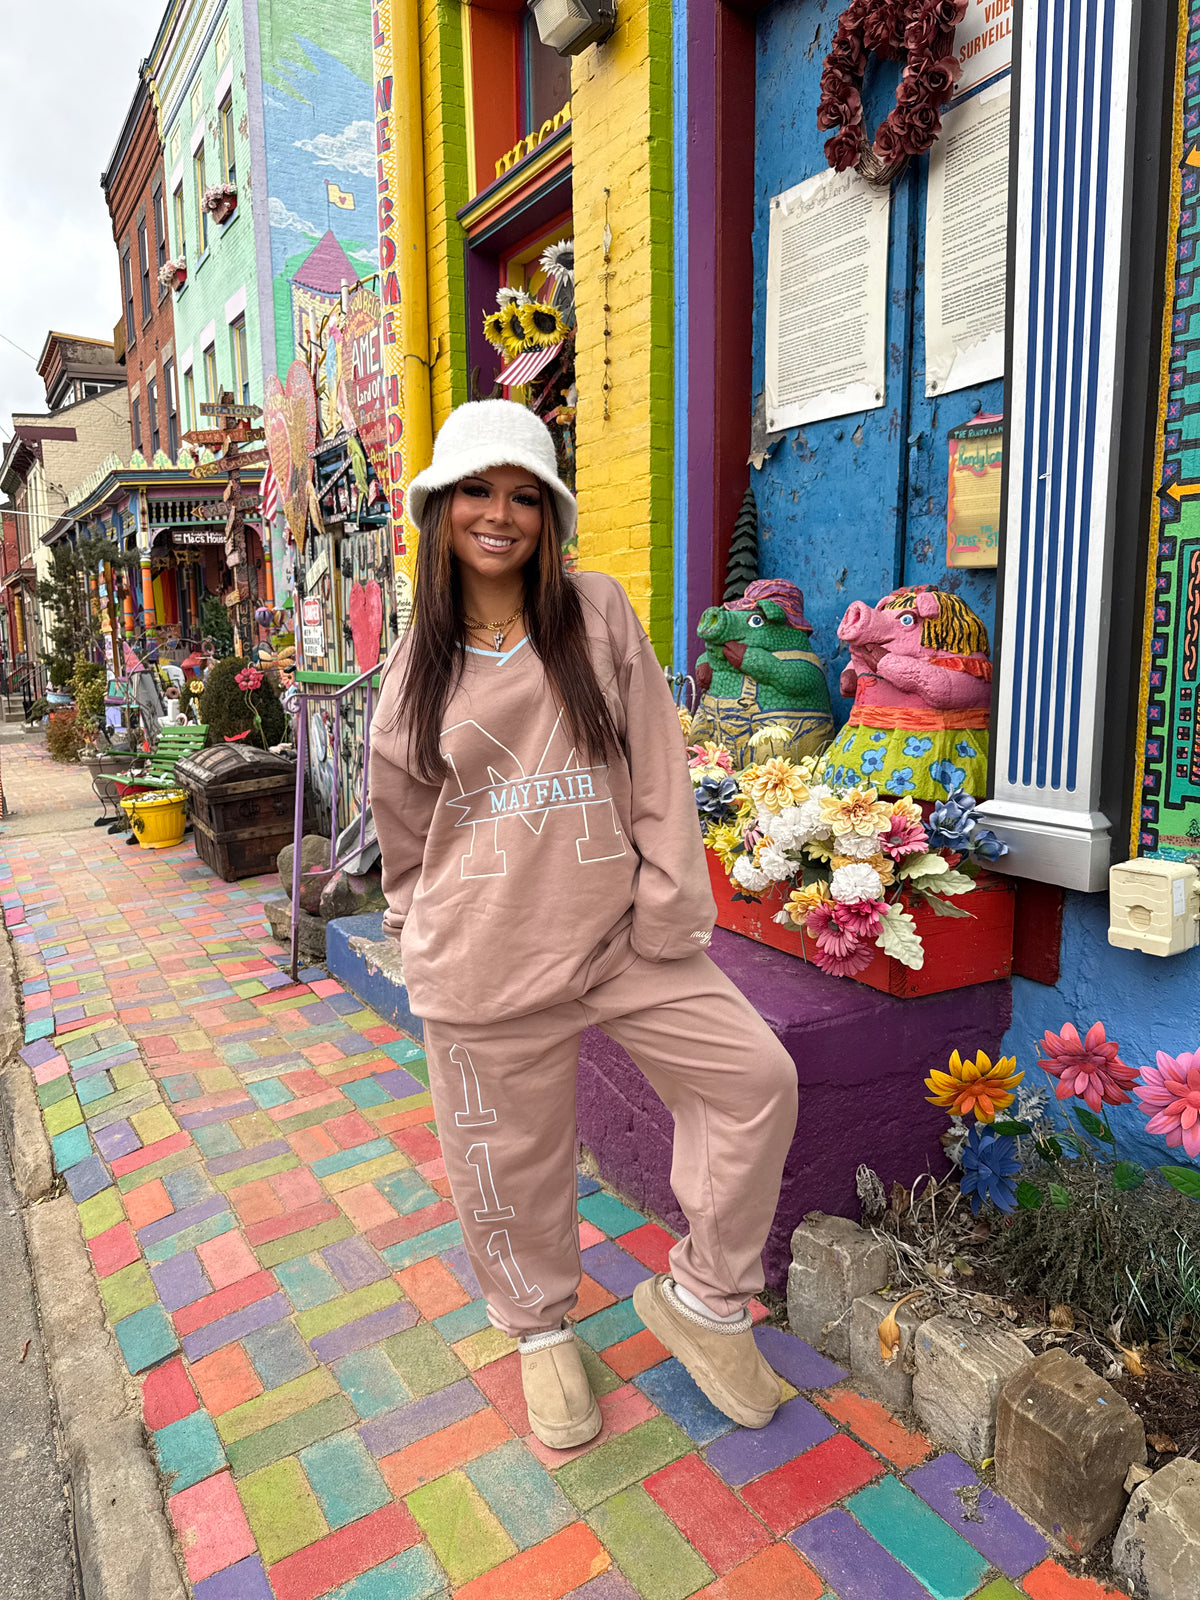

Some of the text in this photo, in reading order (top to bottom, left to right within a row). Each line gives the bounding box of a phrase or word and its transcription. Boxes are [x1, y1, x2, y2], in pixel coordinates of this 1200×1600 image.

[959, 17, 1012, 63] SURVEILL
[375, 75, 402, 345] WELCOME
[205, 406, 260, 416] UP-TOWN
[385, 374, 407, 556] HOUSE
[488, 774, 596, 814] MAYFAIR
